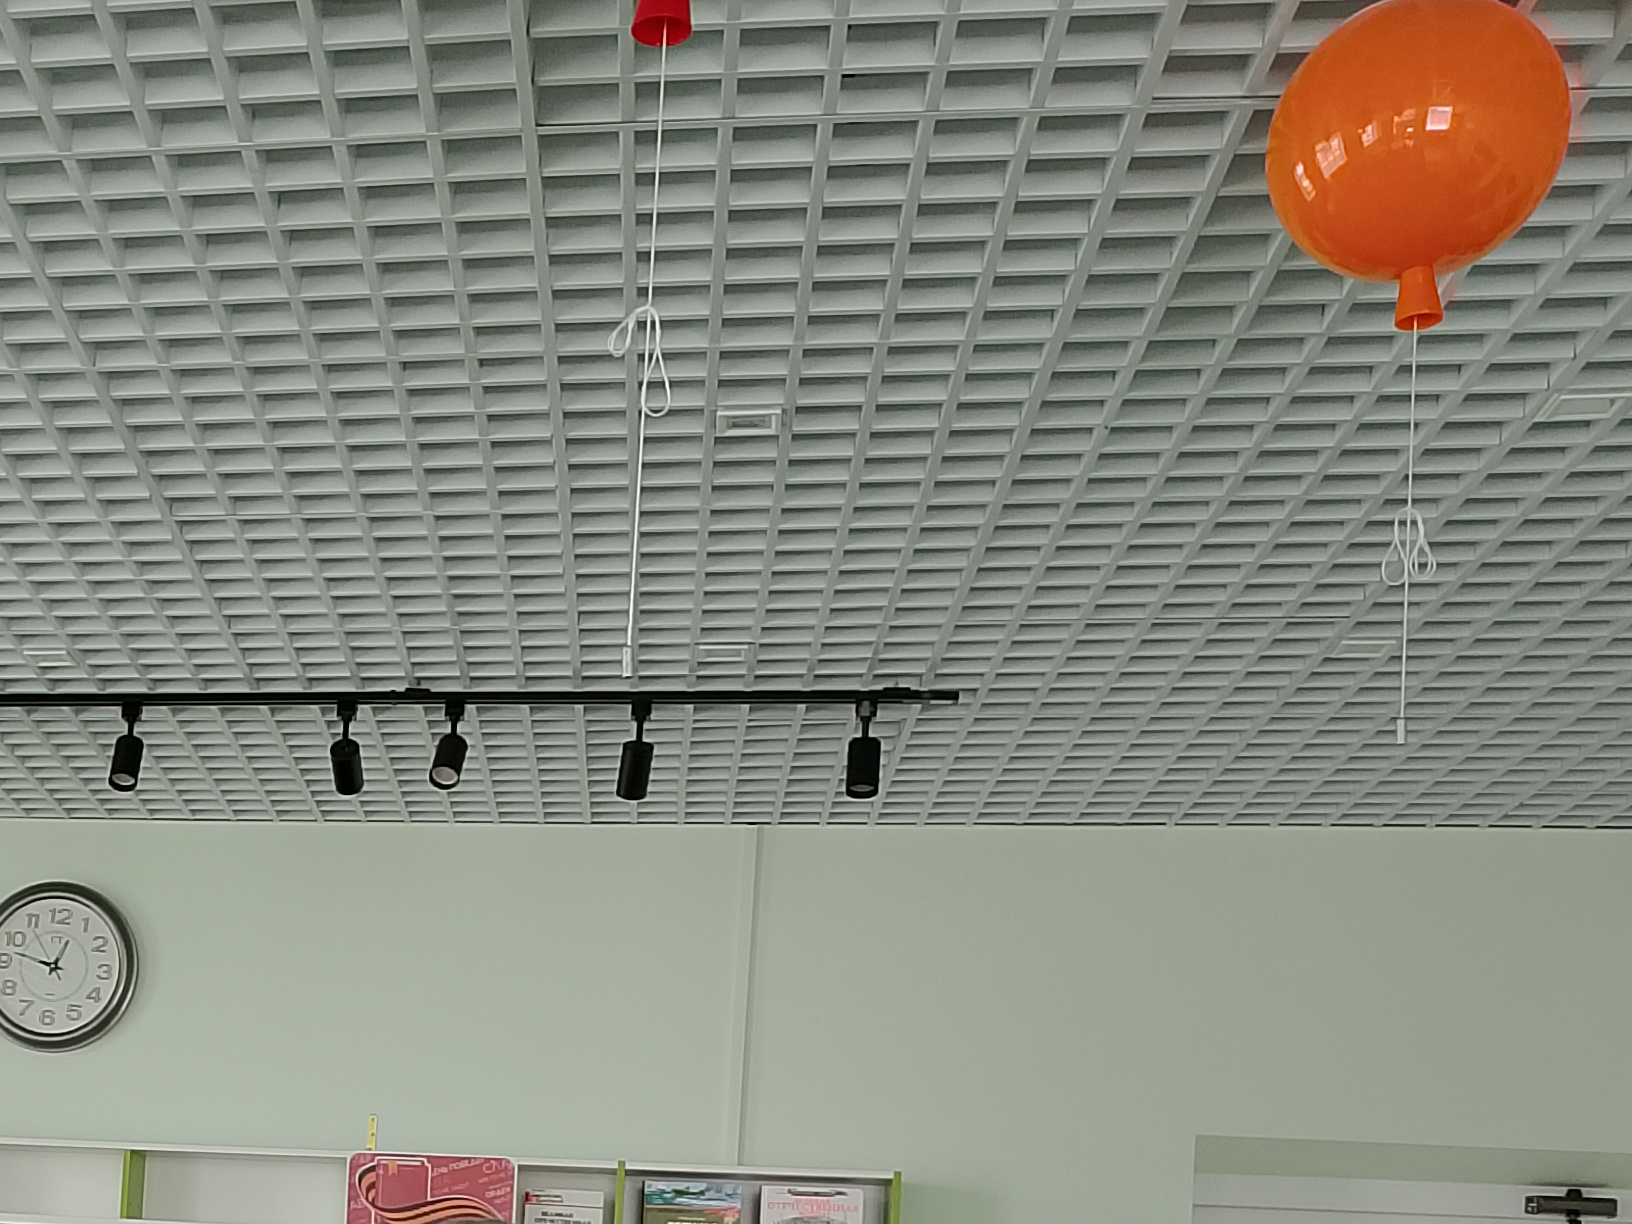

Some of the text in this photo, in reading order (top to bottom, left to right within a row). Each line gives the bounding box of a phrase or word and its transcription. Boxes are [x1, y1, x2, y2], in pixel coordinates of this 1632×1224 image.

[26, 912, 40, 929] 11
[49, 907, 73, 926] 12
[81, 917, 90, 933] 1
[5, 931, 27, 947] 10
[91, 936, 108, 953] 2
[96, 963, 113, 980] 3
[0, 979, 17, 996] 8
[85, 987, 102, 1003] 4
[18, 999, 35, 1016] 7
[66, 1003, 82, 1021] 5
[39, 1009, 55, 1026] 6
